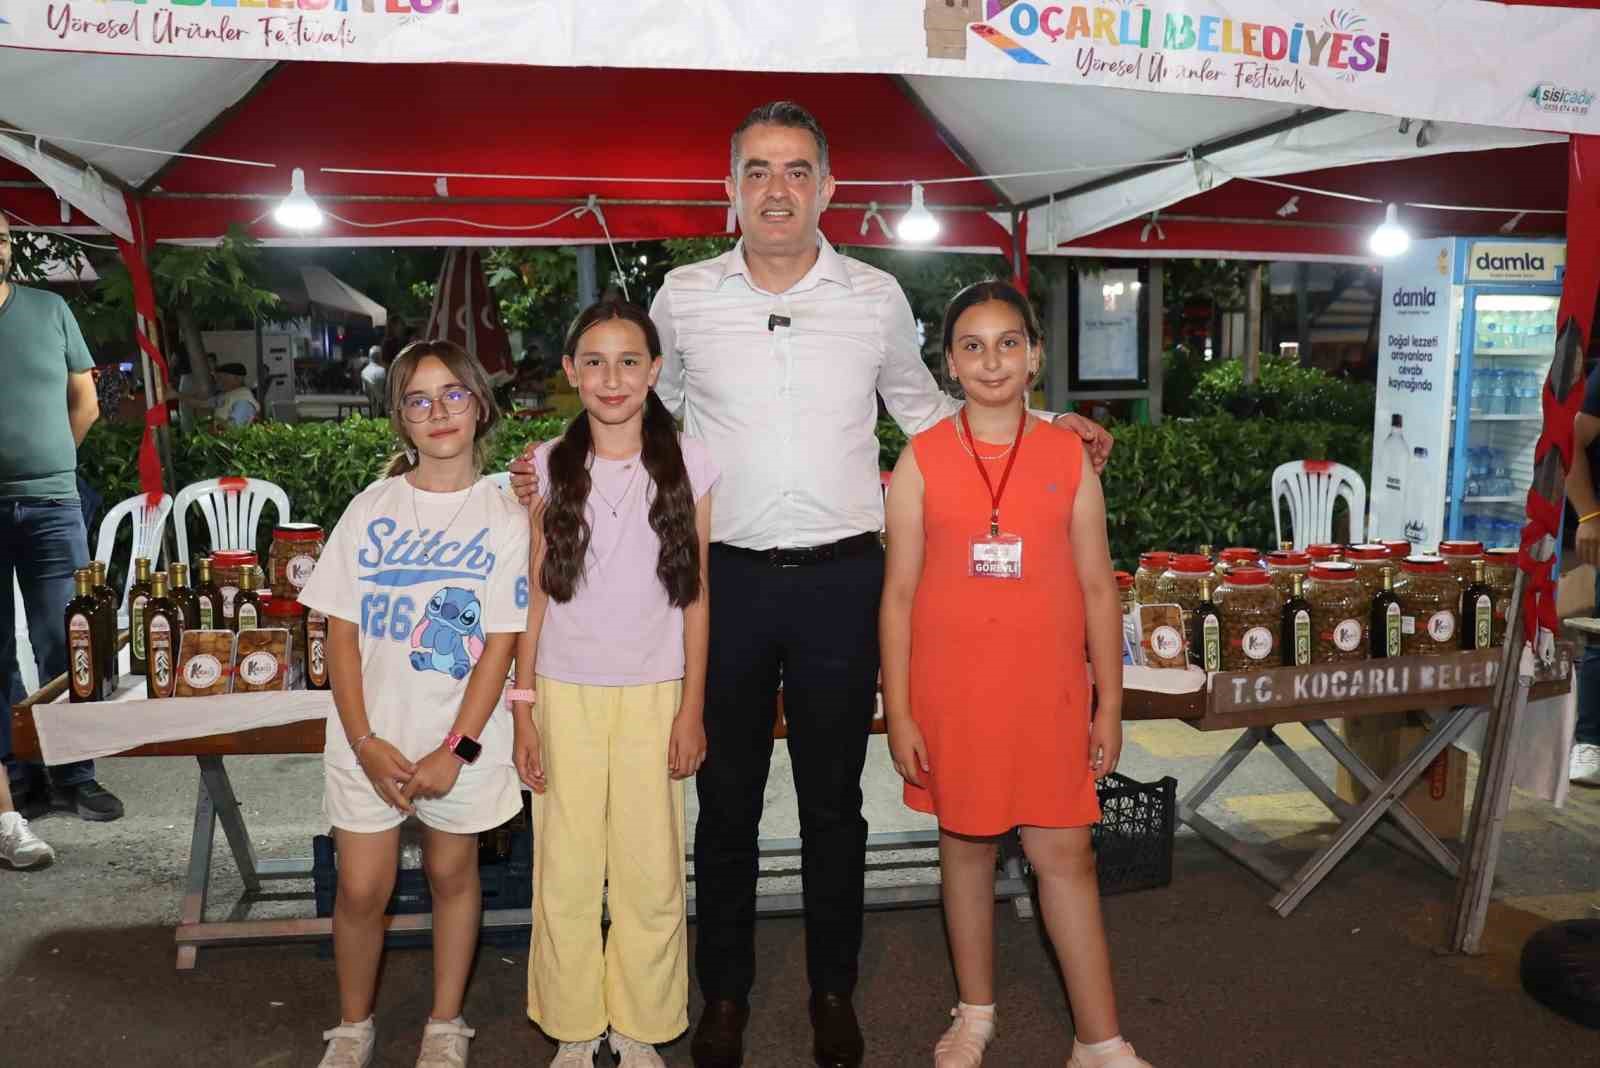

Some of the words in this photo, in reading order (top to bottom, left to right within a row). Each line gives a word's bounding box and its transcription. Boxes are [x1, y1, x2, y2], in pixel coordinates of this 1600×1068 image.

[47, 3, 141, 41] Yöresel
[152, 8, 249, 44] Ürünler
[1162, 12, 1390, 73] BELEDİYESİ
[1075, 47, 1142, 80] Yöresel
[1233, 62, 1307, 96] Festivali
[1476, 252, 1545, 271] damla
[1392, 286, 1437, 308] damla
[1231, 675, 1283, 704] T.C.
